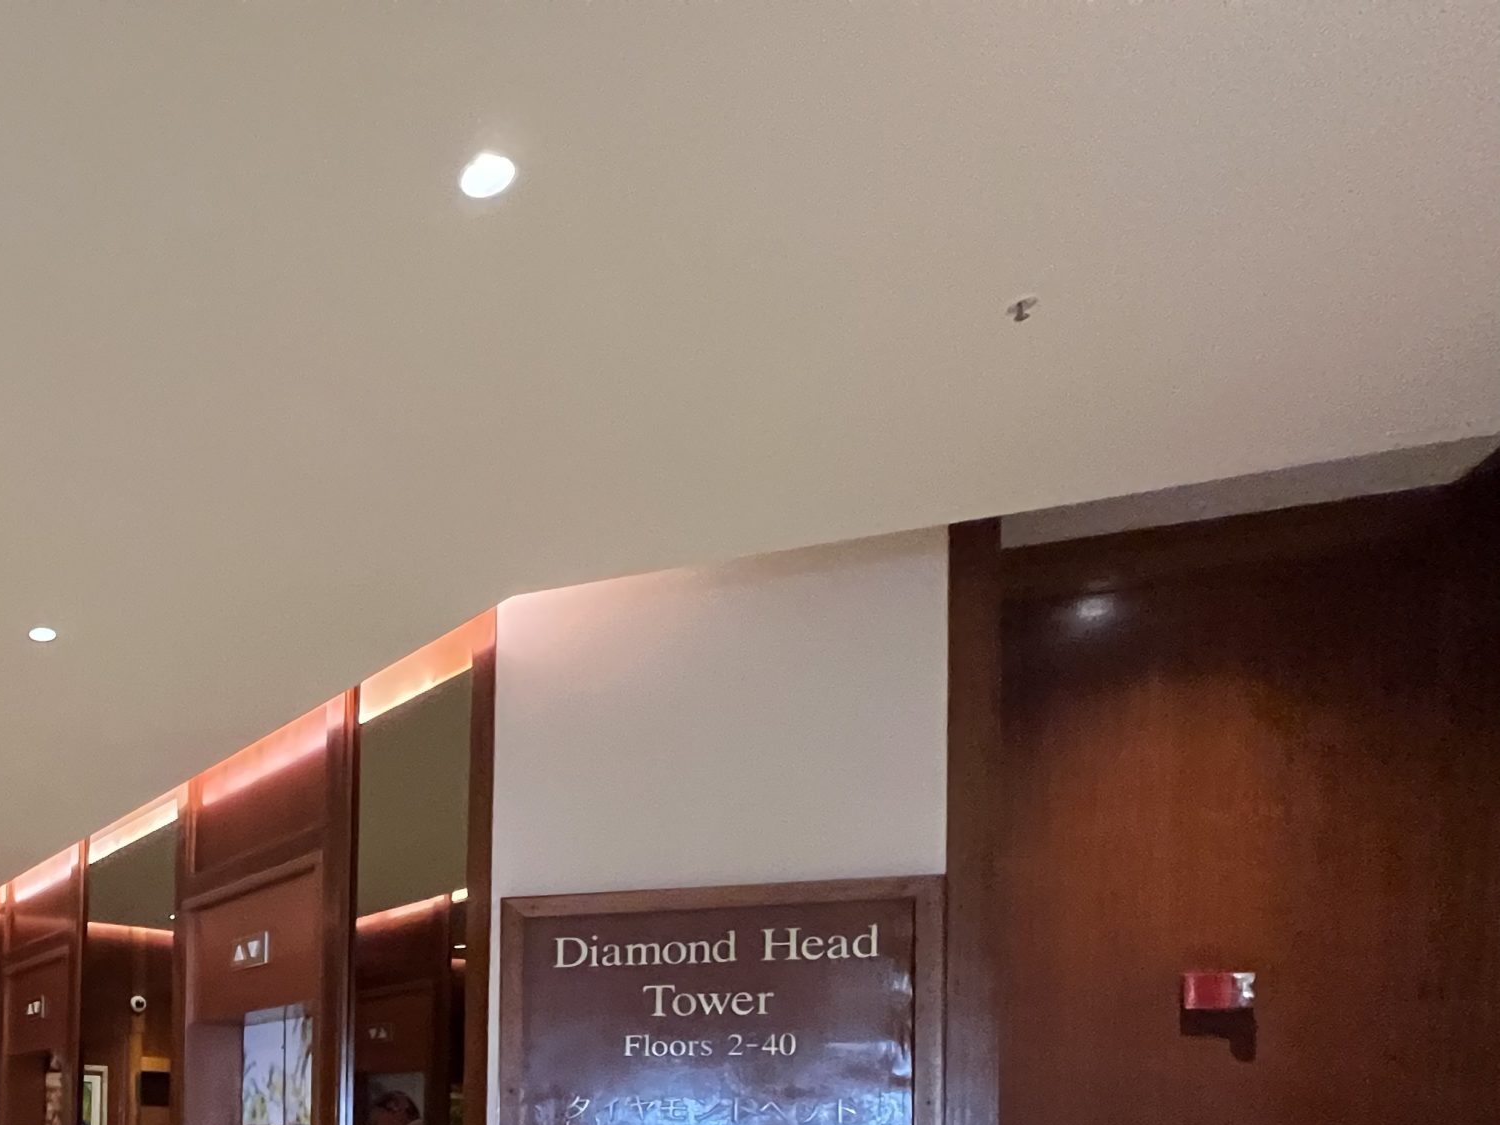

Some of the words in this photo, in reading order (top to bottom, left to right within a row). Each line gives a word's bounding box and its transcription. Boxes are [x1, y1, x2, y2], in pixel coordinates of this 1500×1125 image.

[553, 930, 737, 968] Diamond
[762, 924, 880, 961] Head
[643, 984, 775, 1017] Tower
[623, 1034, 713, 1057] Floors
[728, 1032, 797, 1057] 2-40
